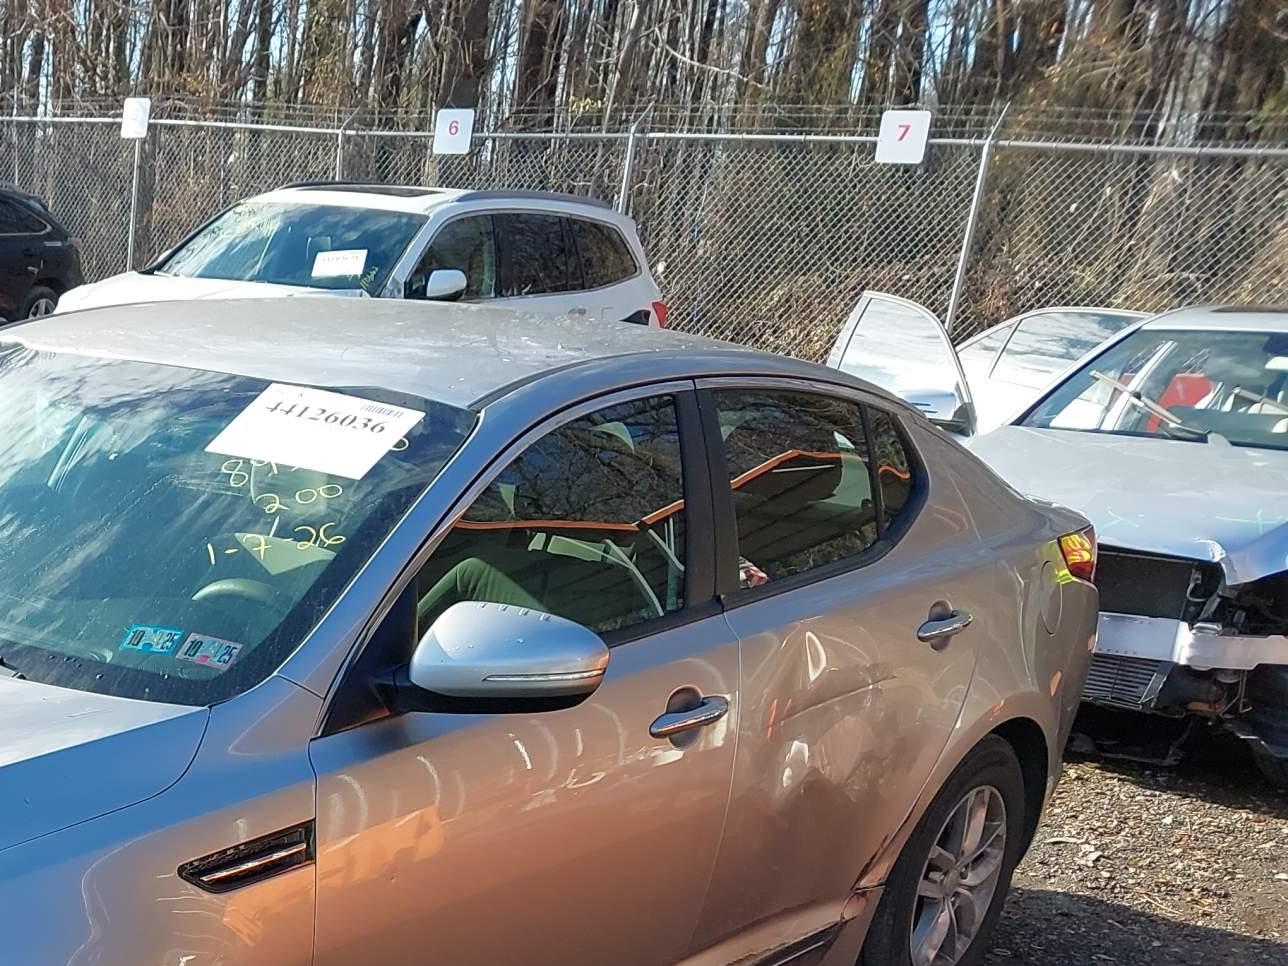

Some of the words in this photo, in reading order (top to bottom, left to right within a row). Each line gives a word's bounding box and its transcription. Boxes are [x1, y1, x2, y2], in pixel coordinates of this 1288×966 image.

[448, 120, 459, 136] 6
[897, 124, 911, 142] 7
[265, 400, 387, 435] 44126036
[128, 629, 145, 647] 10
[160, 632, 178, 650] 25
[183, 639, 203, 657] 10
[217, 645, 237, 664] 25
